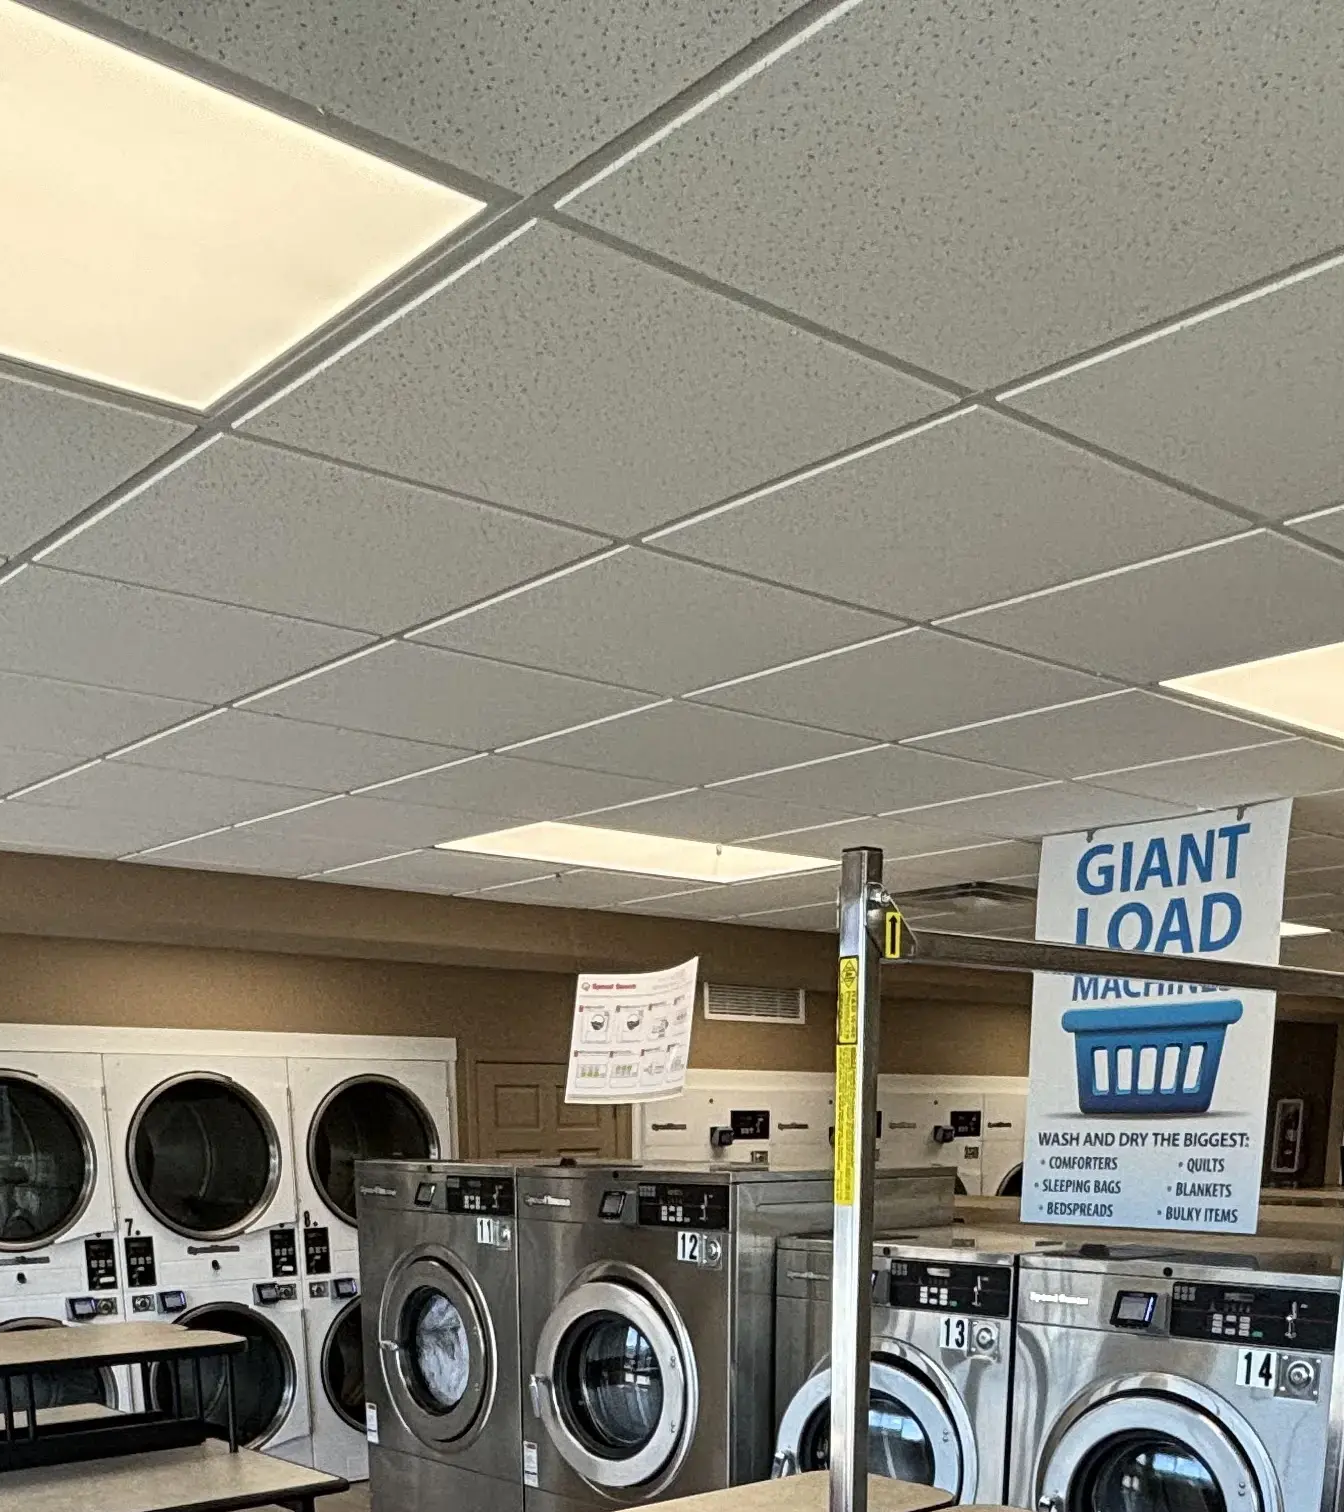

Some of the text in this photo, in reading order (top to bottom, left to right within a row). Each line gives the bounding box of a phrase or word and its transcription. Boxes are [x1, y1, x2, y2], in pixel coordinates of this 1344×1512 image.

[1076, 823, 1251, 896] GIANT
[1076, 892, 1242, 953] LOAD
[1072, 975, 1231, 1001] MACH
[1038, 1132, 1250, 1148] WASH AND DRY THE BIGGEST:
[1049, 1156, 1118, 1170] COMFORTERS
[1187, 1157, 1225, 1173] QUILTS
[1042, 1179, 1122, 1194] SLEEPING BAGS
[1175, 1182, 1232, 1198] BLANKETS
[1047, 1202, 1113, 1217] BEDSPREADS
[1165, 1206, 1239, 1223] BULKY ITEMS
[478, 1218, 493, 1243] 11
[680, 1234, 699, 1260] 12
[943, 1319, 966, 1348] 13
[1244, 1351, 1273, 1387] 14
